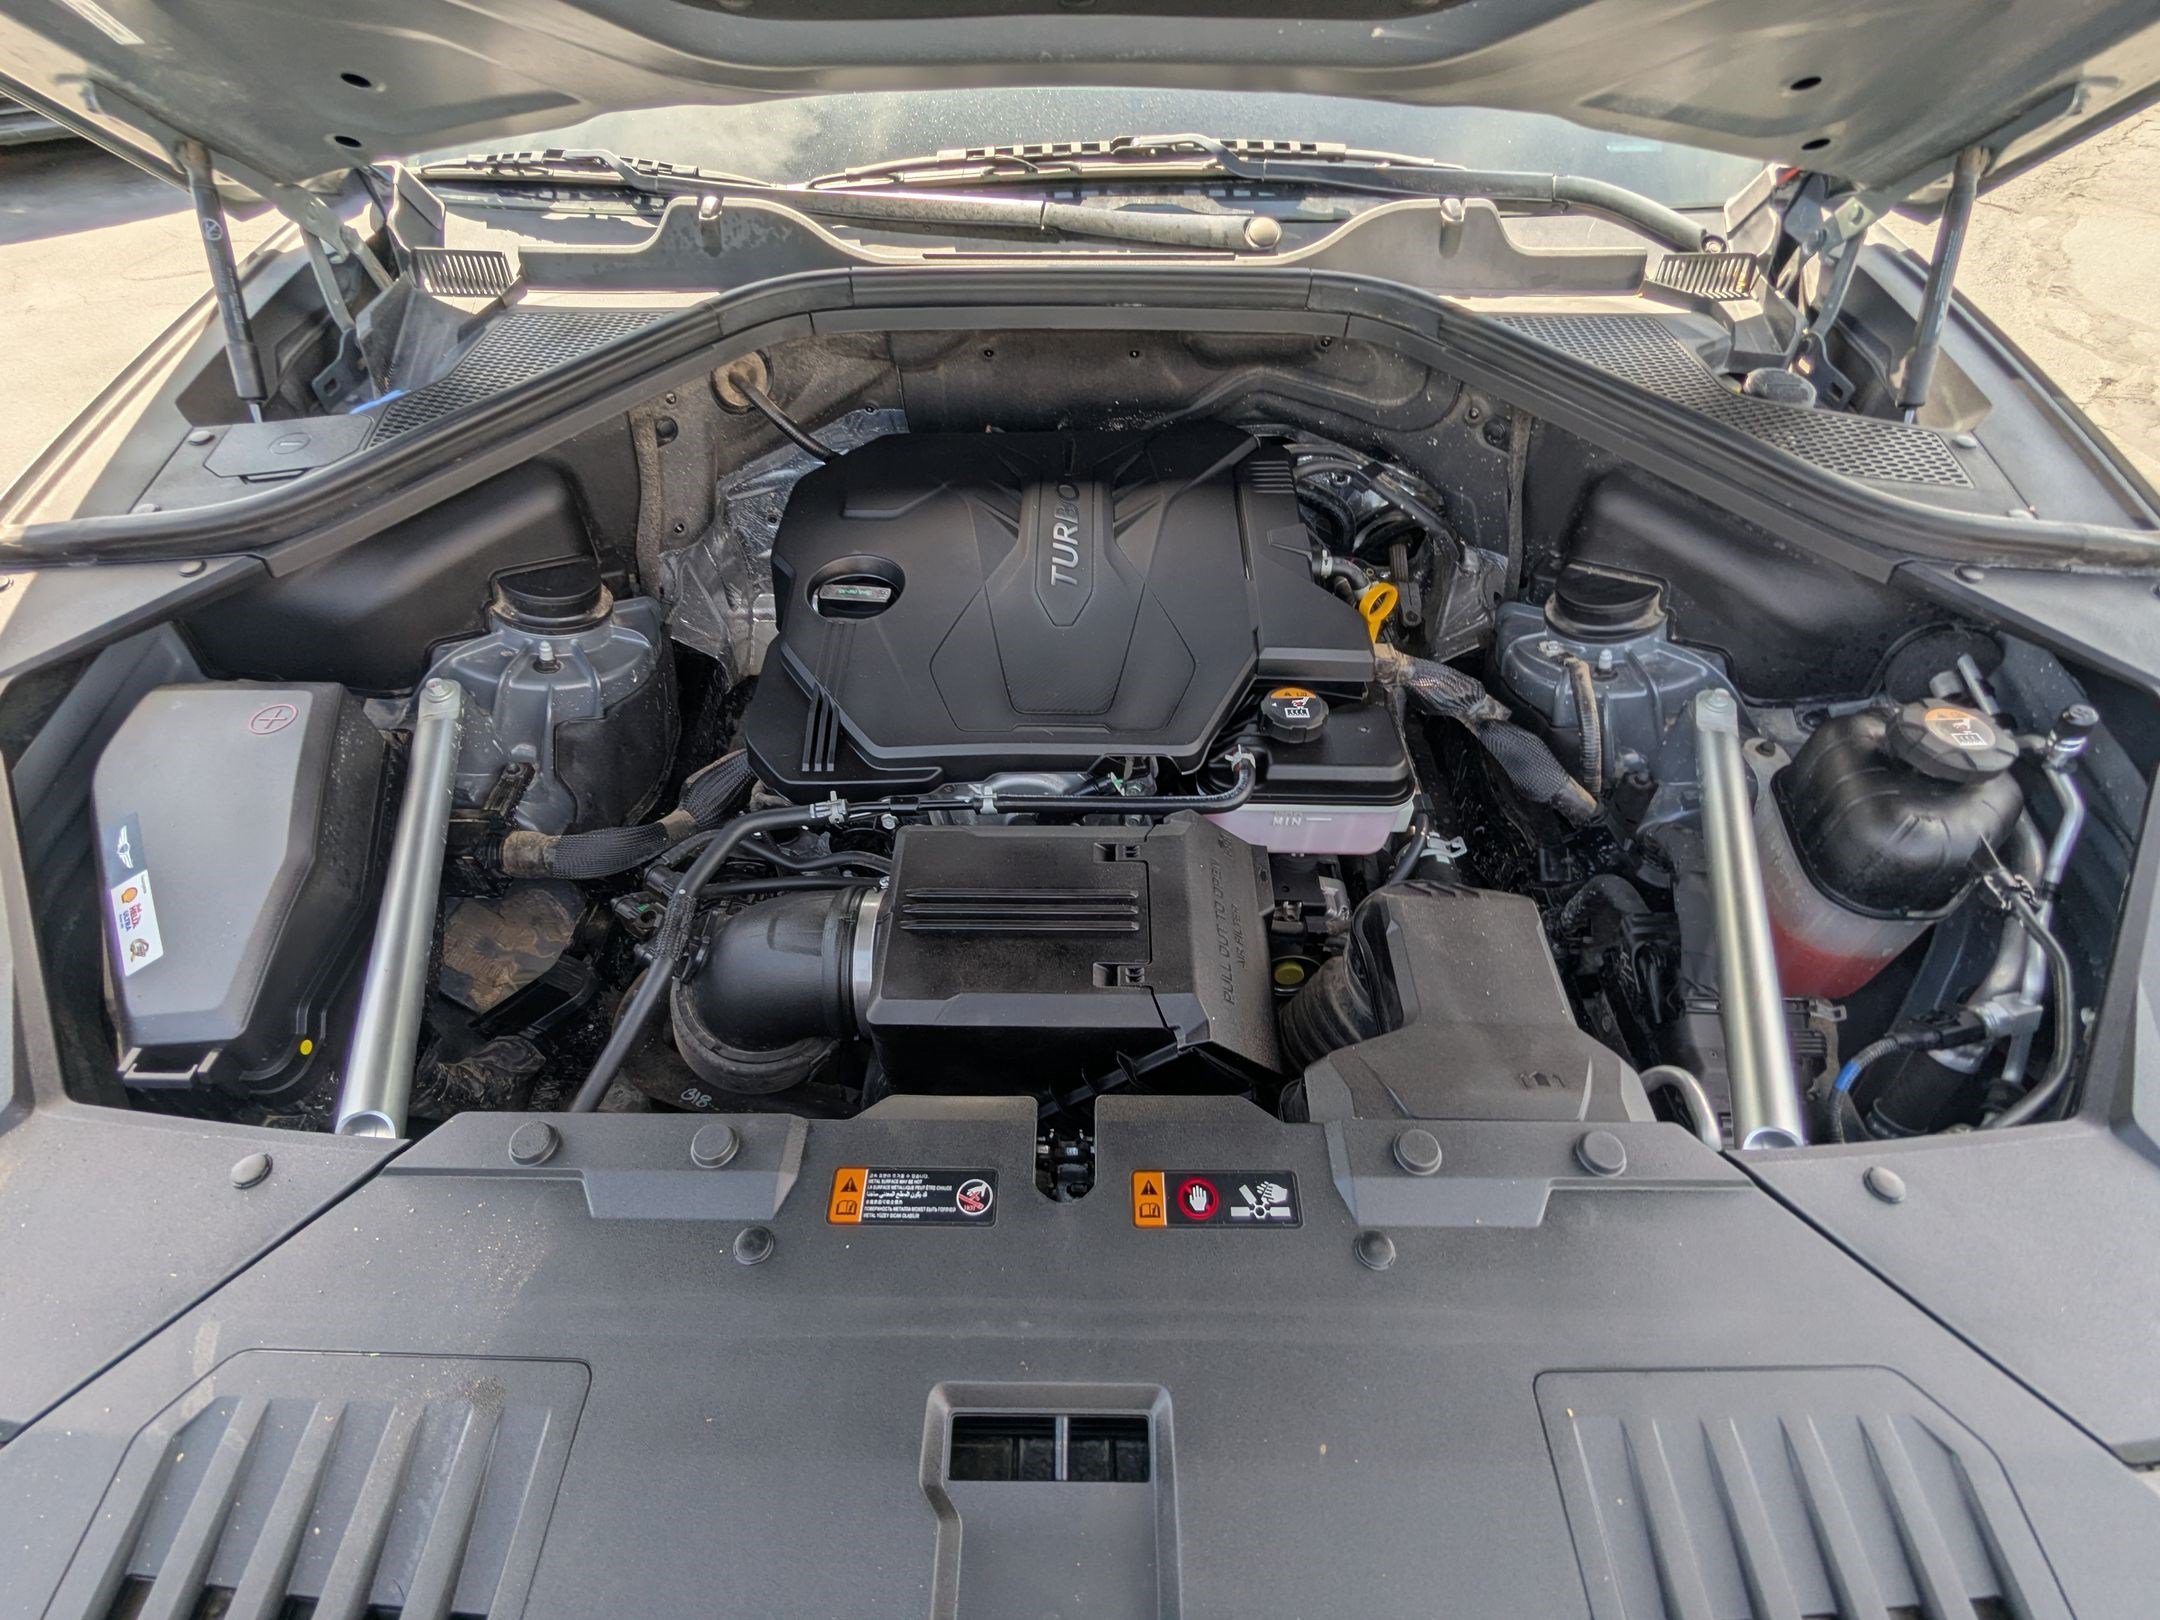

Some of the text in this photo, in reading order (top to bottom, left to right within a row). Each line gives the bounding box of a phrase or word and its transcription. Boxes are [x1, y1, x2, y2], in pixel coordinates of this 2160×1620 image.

[1050, 484, 1080, 586] TURBO
[1272, 815, 1302, 827] MIN
[1211, 858, 1235, 1006] PULL OUT TO OPEN
[1230, 902, 1246, 949] FILTER
